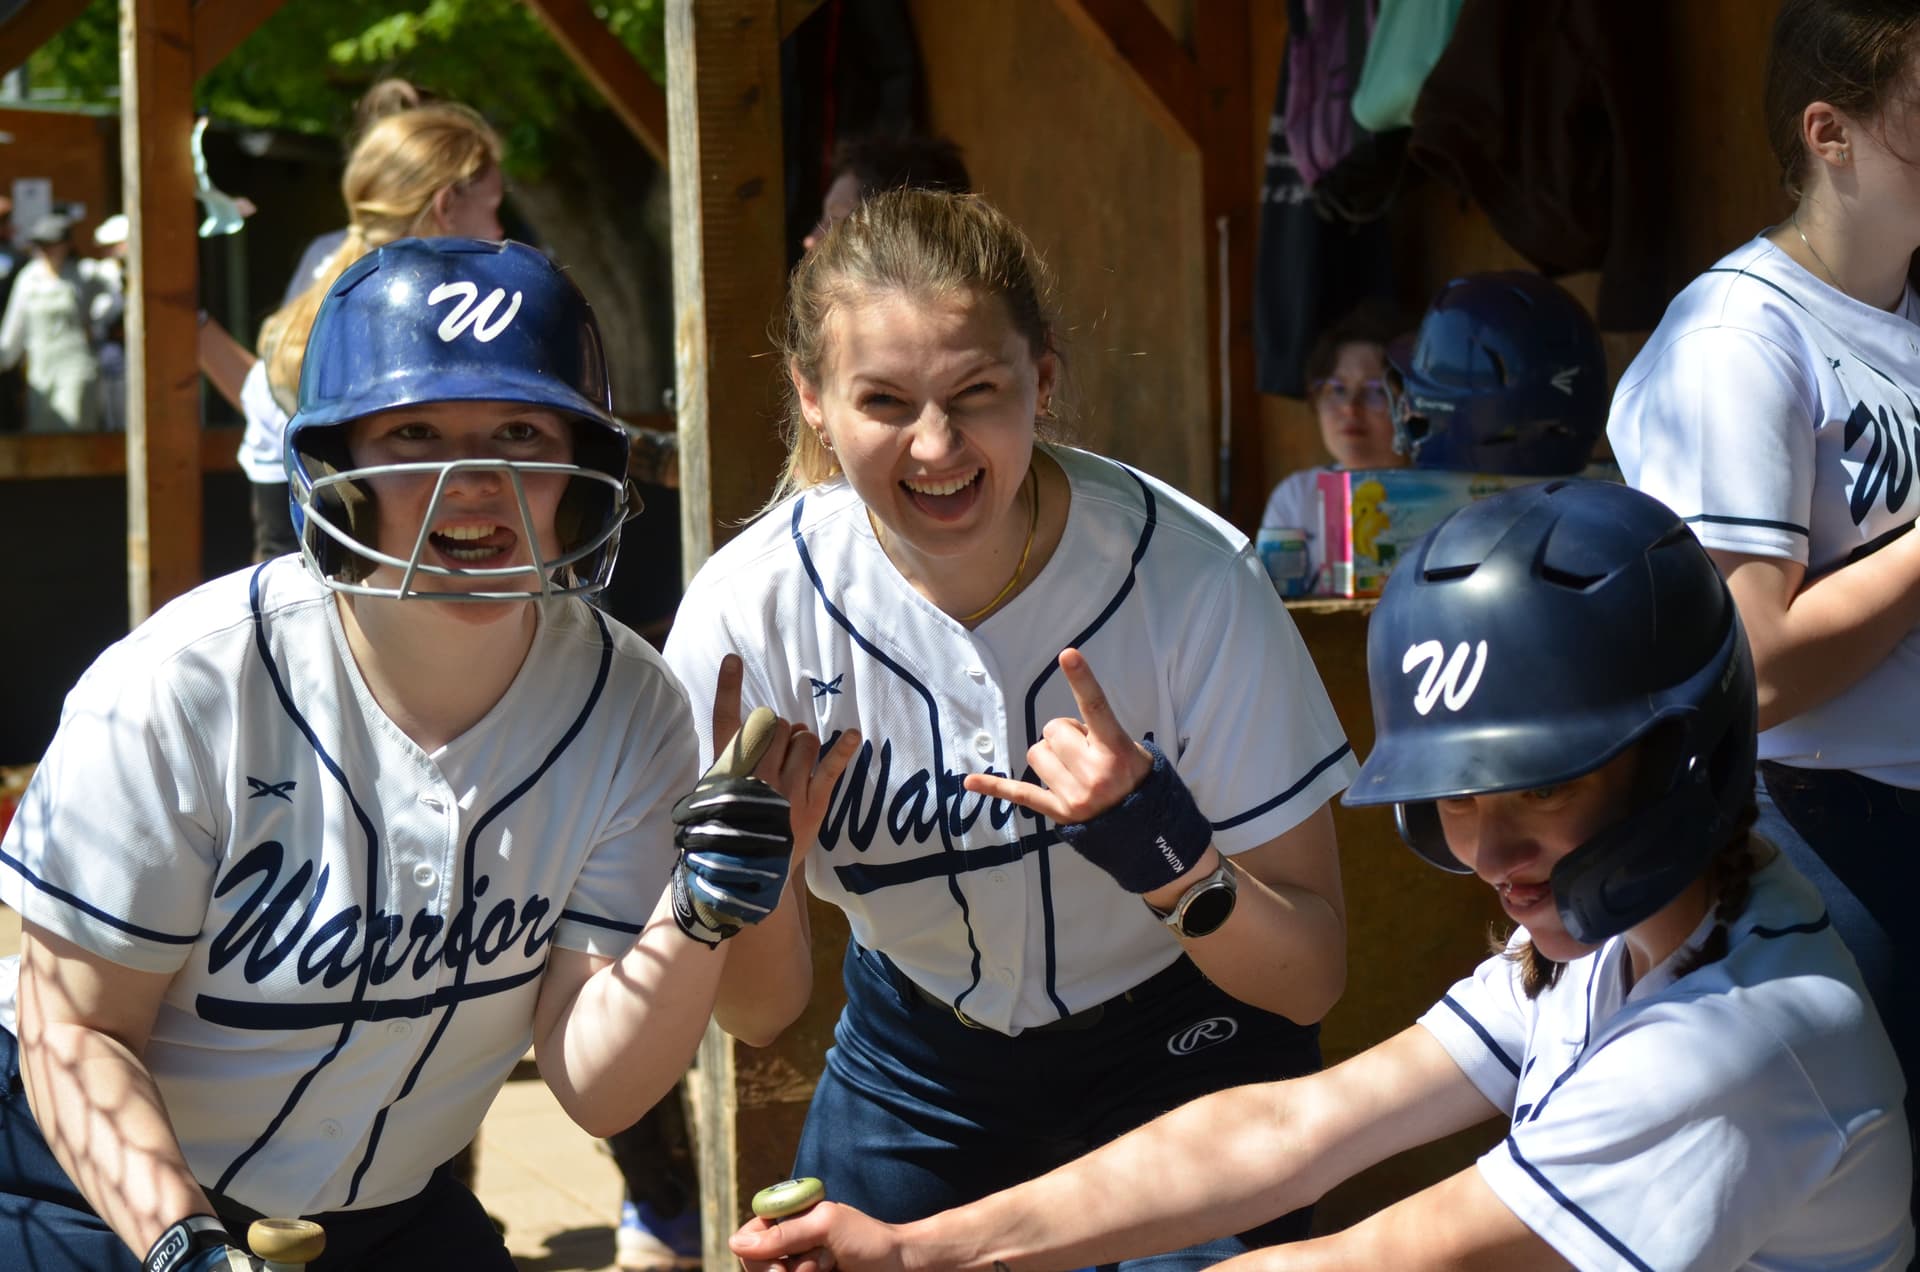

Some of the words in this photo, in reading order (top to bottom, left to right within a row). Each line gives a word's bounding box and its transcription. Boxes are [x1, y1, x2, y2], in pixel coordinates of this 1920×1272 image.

[428, 281, 522, 342] W
[1844, 400, 1920, 526] W
[1402, 639, 1487, 715] W
[1155, 836, 1185, 873] KUIKMA
[208, 840, 559, 988] Warrior
[150, 1236, 183, 1272] LOUIS
